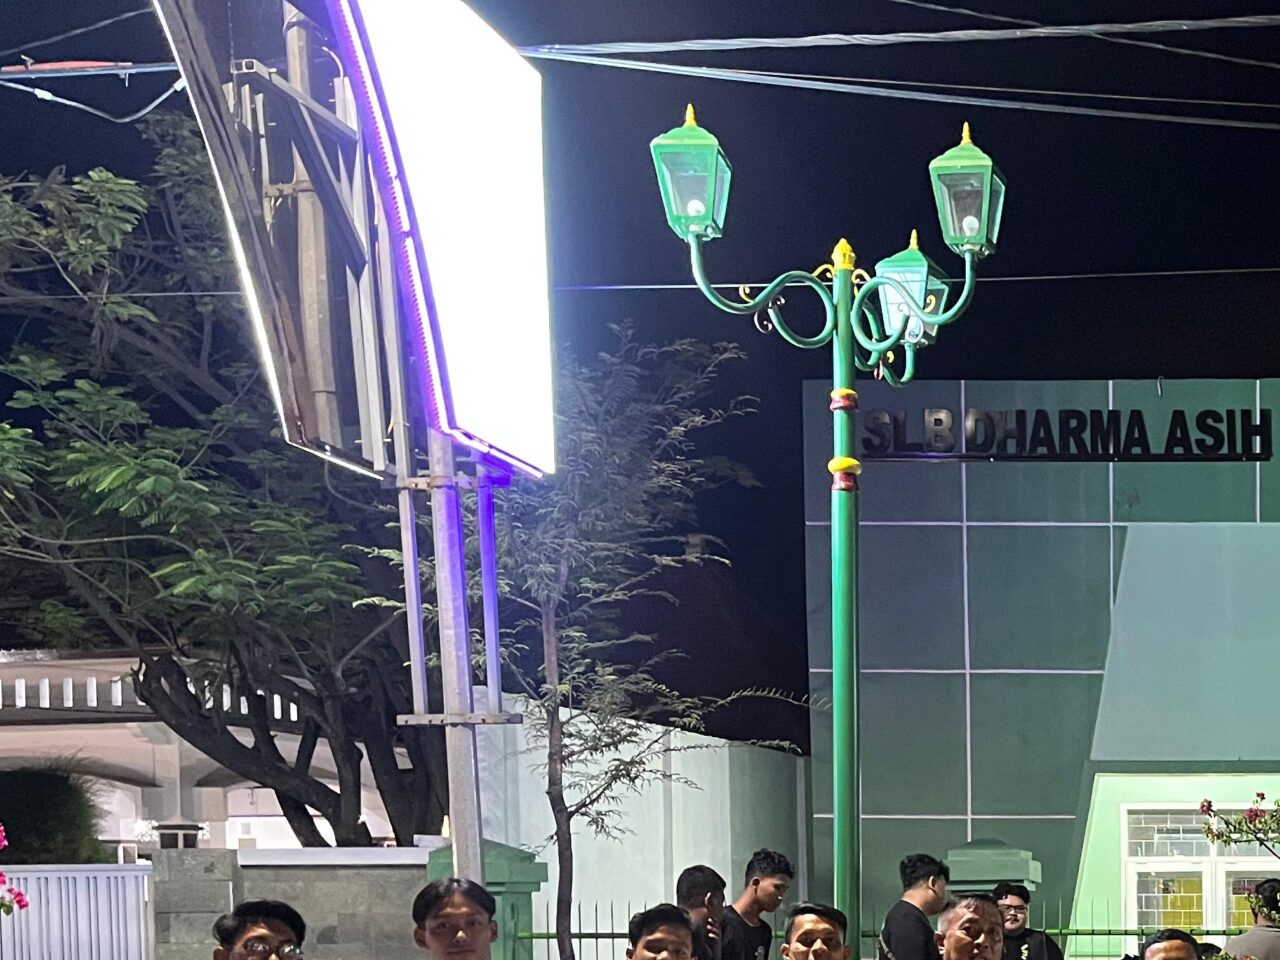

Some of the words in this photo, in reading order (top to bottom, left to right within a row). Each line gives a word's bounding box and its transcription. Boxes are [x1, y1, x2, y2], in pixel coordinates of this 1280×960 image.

[861, 409, 954, 454] SLB
[964, 409, 1150, 456] DHARMA
[1163, 409, 1273, 456] ASIH
